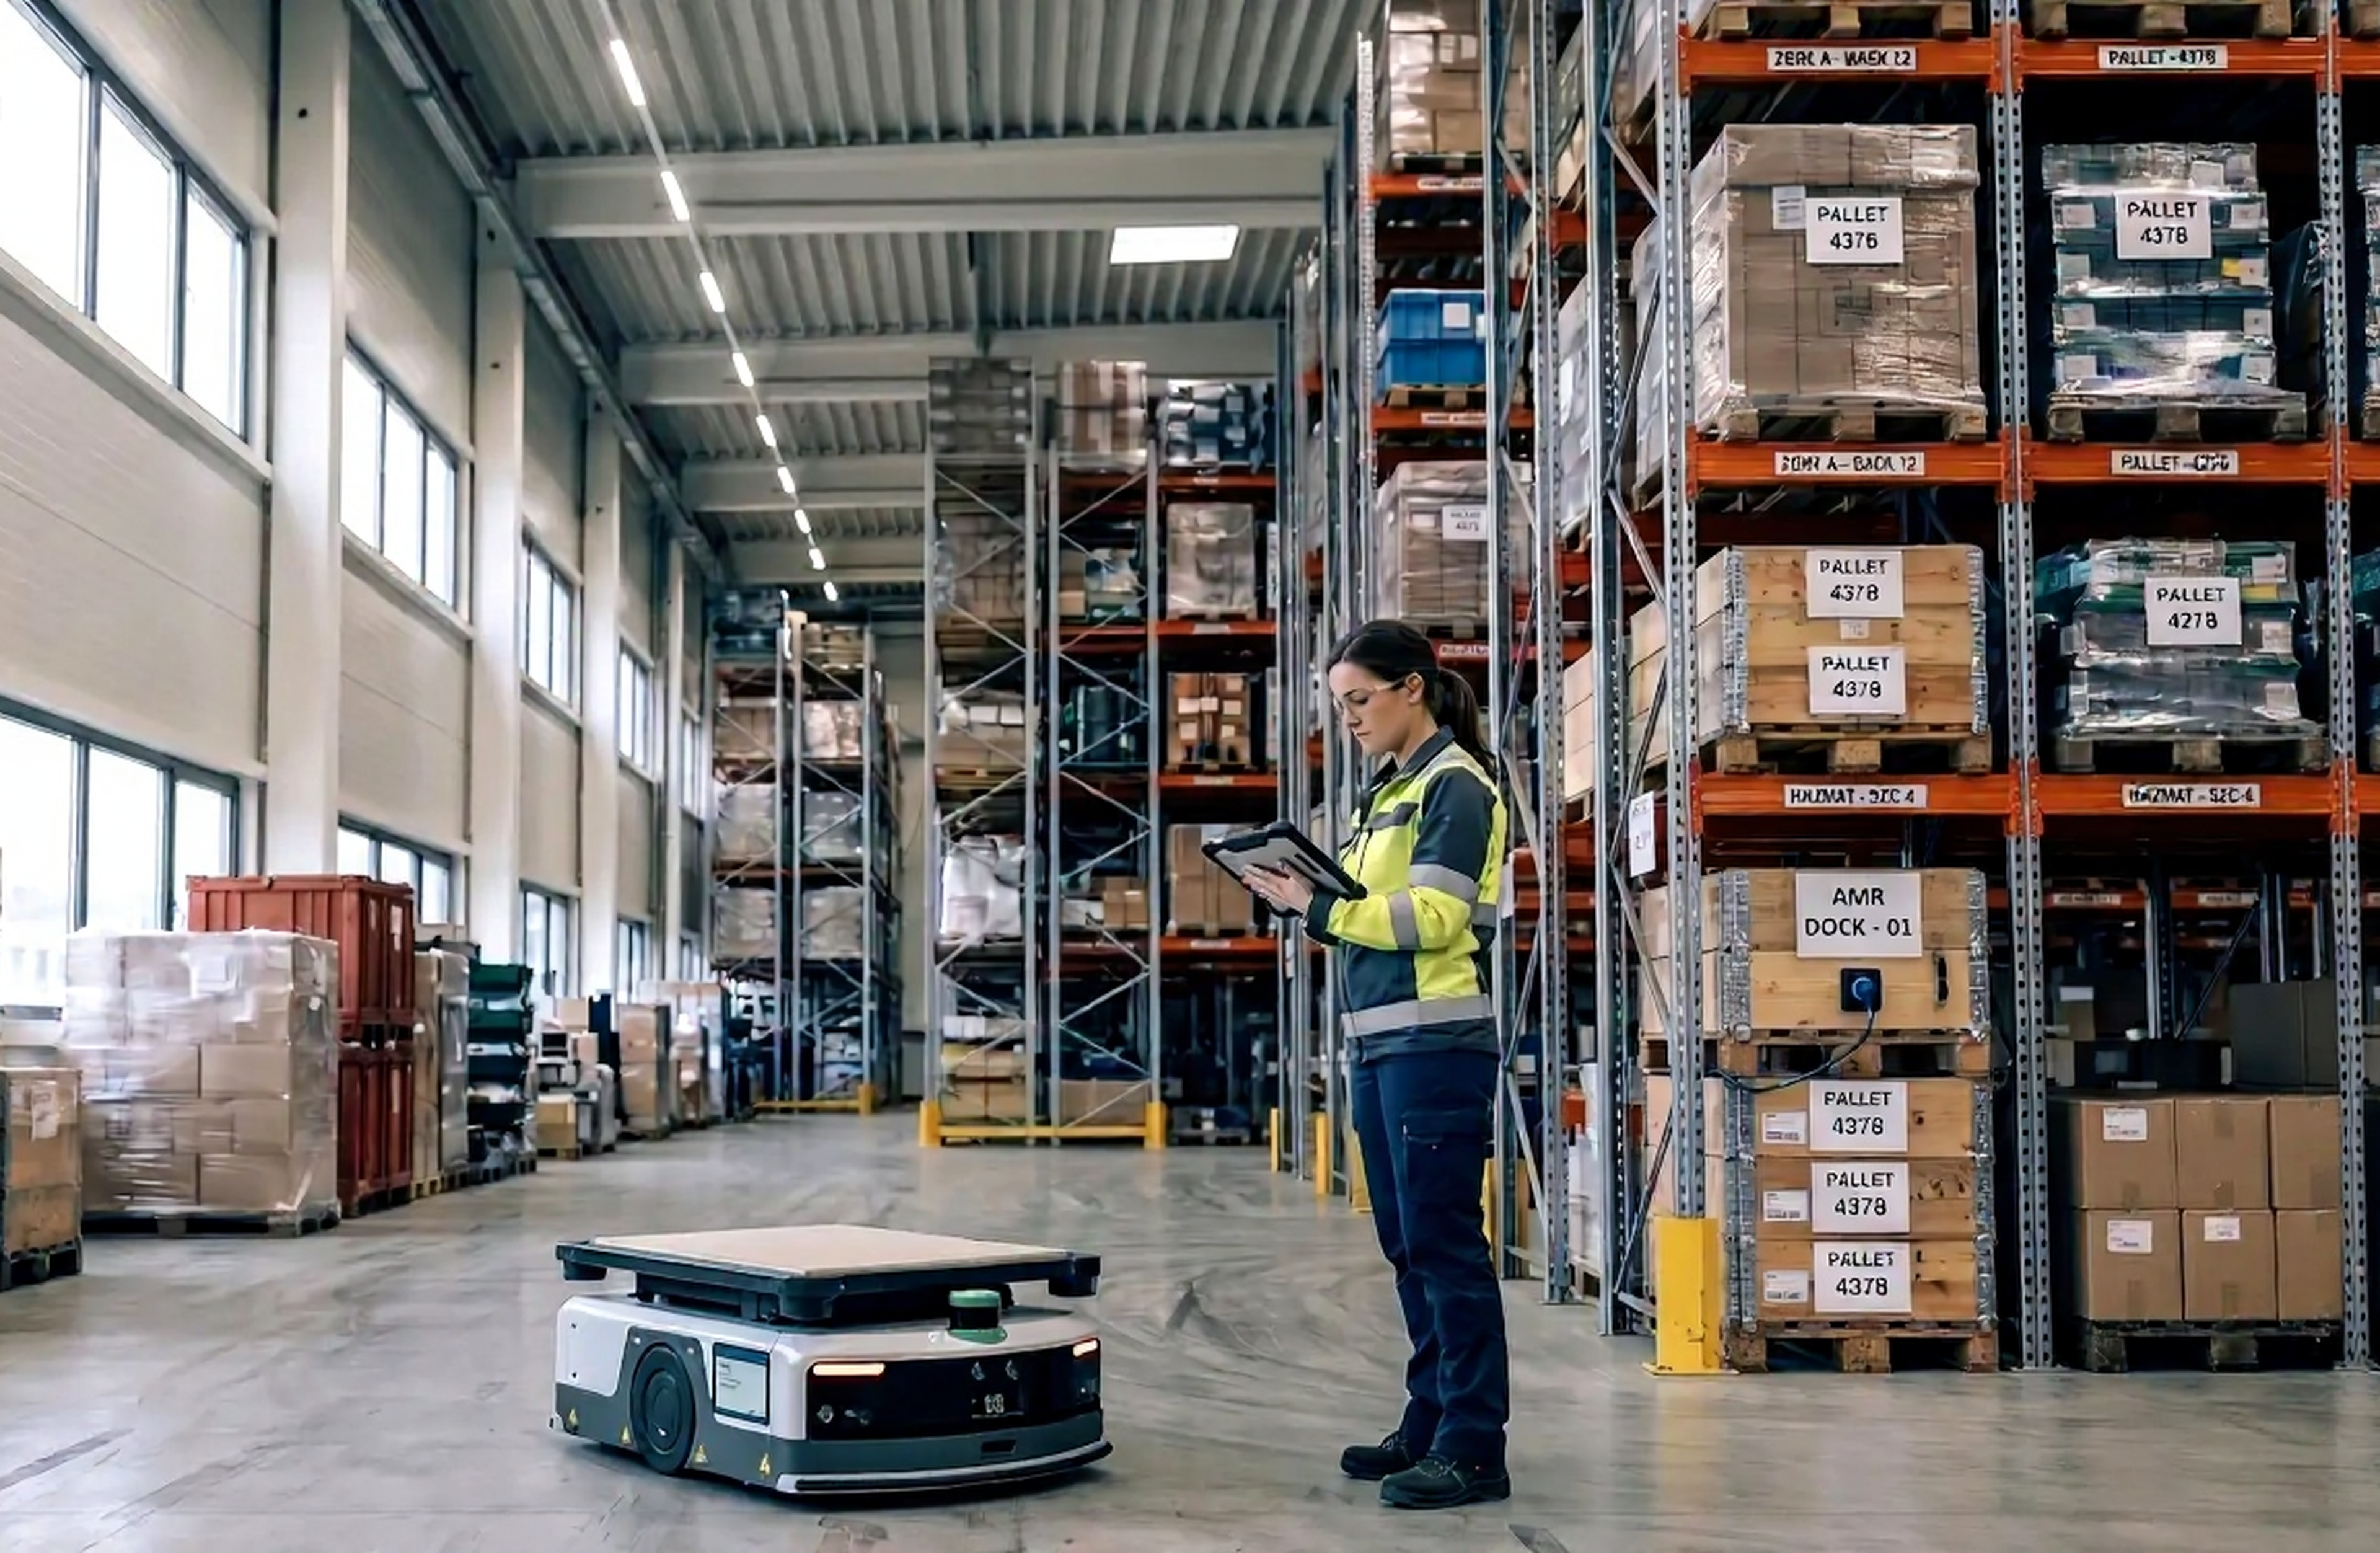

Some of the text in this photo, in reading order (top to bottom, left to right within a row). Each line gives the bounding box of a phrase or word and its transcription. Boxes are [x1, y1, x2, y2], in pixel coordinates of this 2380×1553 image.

[1817, 206, 1889, 222] PALLET
[2127, 200, 2197, 218] PALLET
[1820, 560, 1888, 574] PALLET
[2157, 588, 2226, 602] PALLET
[2169, 611, 2218, 629] 4278
[1822, 656, 1889, 671] PALLET
[1833, 681, 1881, 698] 4378
[1833, 888, 1884, 906] AMR
[1805, 918, 1866, 936] DOCK
[1887, 918, 1912, 936] 01
[1824, 1091, 1892, 1105] PALLET
[1826, 1172, 1895, 1187] PALLET
[1835, 1197, 1886, 1215] 4378
[1828, 1252, 1894, 1267] PALLET
[1836, 1278, 1888, 1295] 4378
